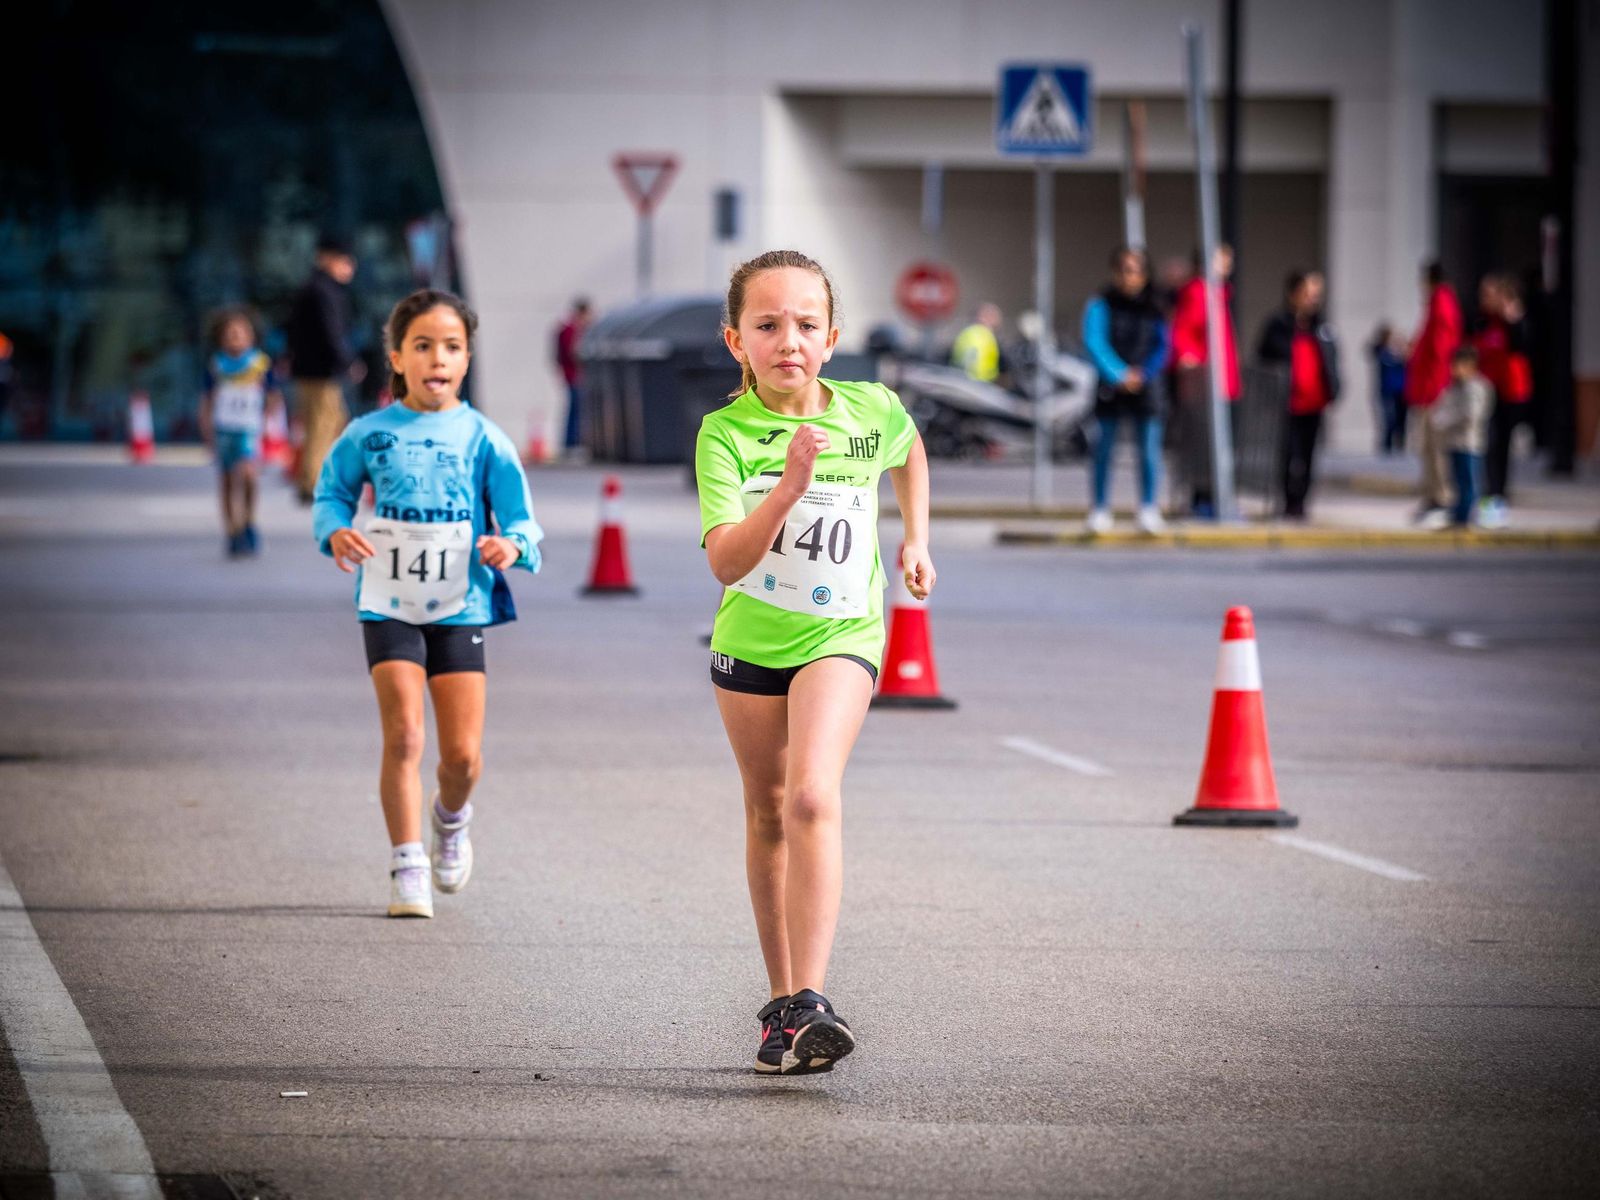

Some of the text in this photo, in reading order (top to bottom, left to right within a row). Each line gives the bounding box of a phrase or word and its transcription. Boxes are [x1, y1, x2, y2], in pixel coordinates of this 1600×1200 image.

[815, 474, 855, 483] SEAT
[769, 516, 852, 564] 140
[387, 546, 449, 582] 141
